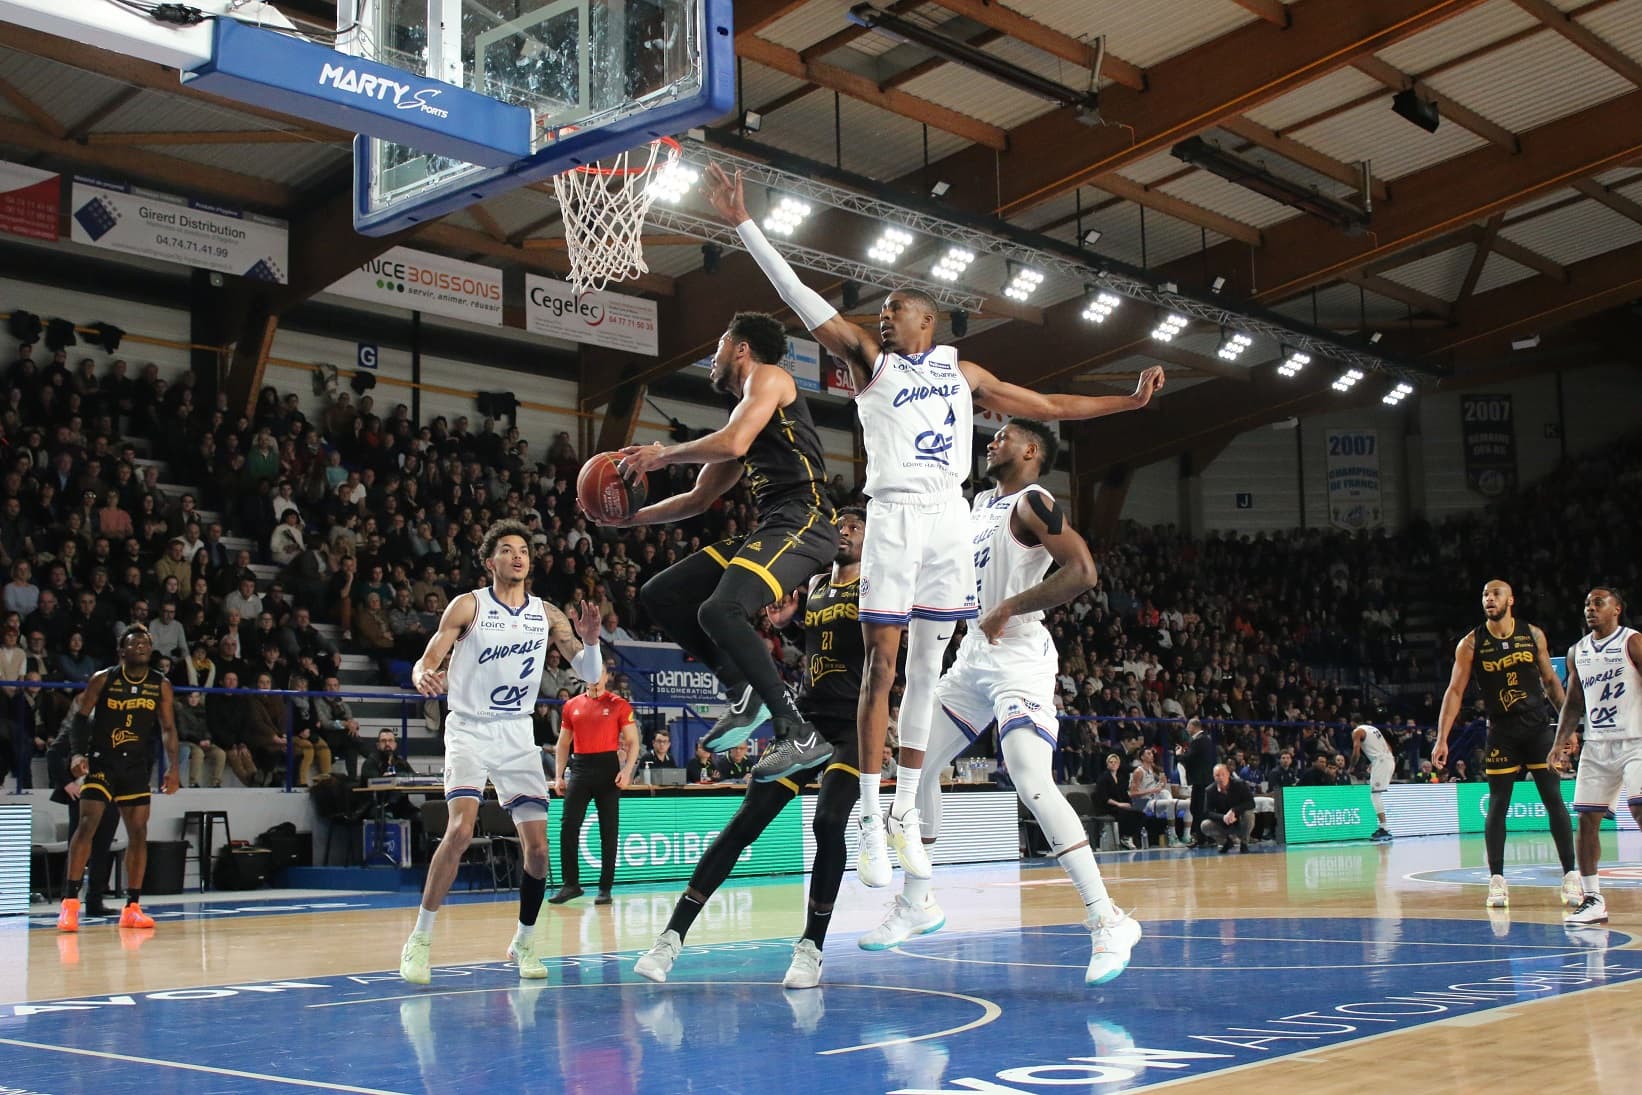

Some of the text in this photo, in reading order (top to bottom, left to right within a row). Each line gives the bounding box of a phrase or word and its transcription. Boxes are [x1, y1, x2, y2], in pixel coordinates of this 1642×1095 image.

[318, 63, 410, 104] MARTY
[138, 206, 175, 224] Girerd
[179, 215, 246, 240] Distribution
[156, 234, 228, 258] 04.74.71.41.99
[360, 258, 500, 301] NCE BOISSONS
[530, 287, 599, 318] Cegelec
[360, 347, 375, 366] G
[944, 403, 956, 427] 4
[1463, 399, 1511, 422] 2007
[1328, 435, 1376, 456] 2007
[1240, 495, 1249, 508] J
[804, 602, 859, 627] BYERS
[821, 630, 833, 651] 21
[519, 656, 535, 680] 2
[1482, 650, 1534, 672] BYERS
[650, 670, 712, 689] oannais
[1506, 671, 1518, 686] 22
[1599, 682, 1626, 702] 42
[107, 697, 156, 711] BYERS
